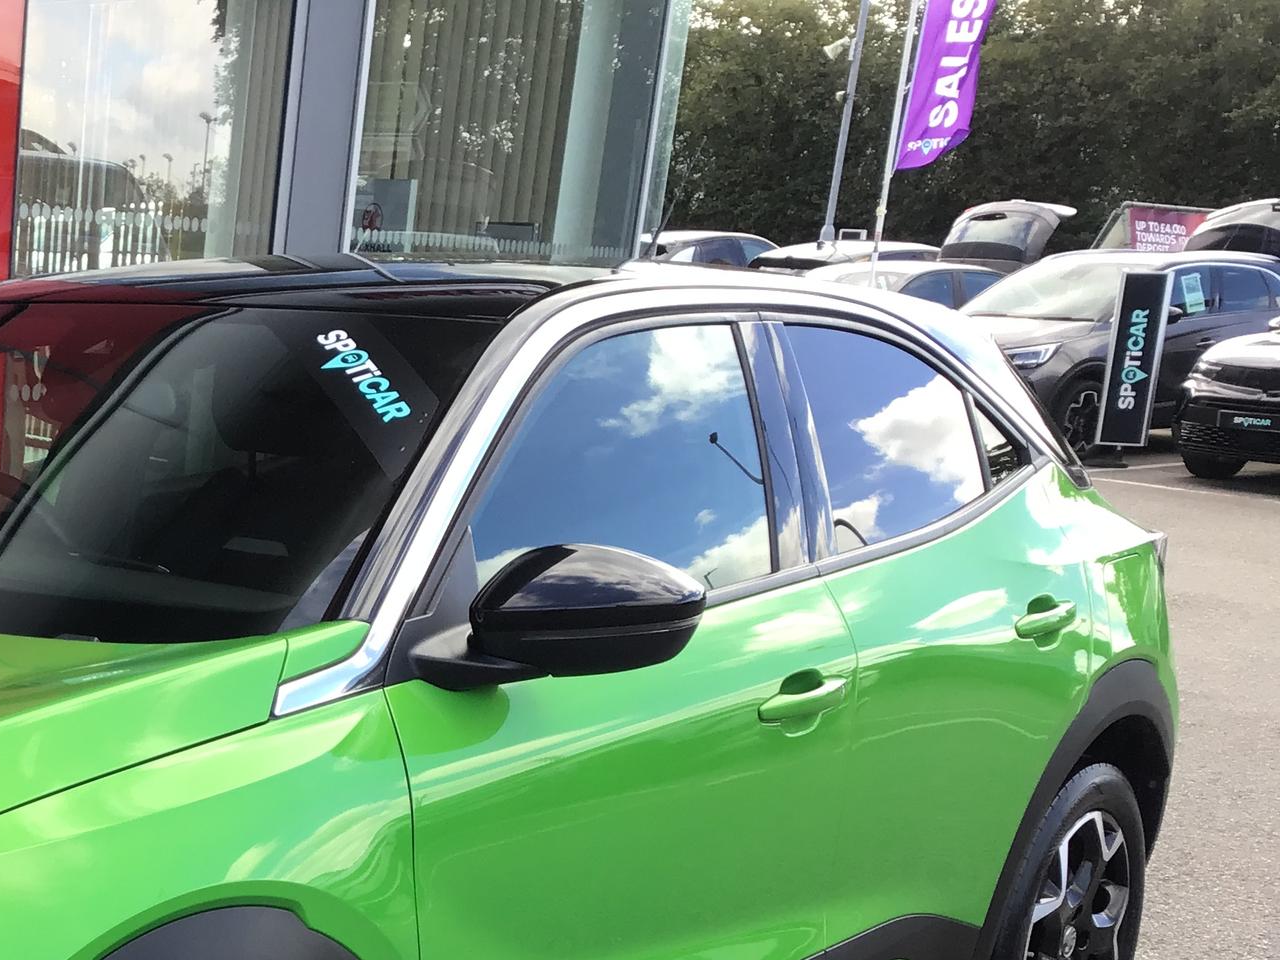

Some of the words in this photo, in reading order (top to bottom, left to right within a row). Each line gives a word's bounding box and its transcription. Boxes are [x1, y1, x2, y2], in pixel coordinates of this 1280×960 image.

[928, 0, 988, 128] SALES
[1135, 220, 1147, 231] UP
[1148, 221, 1160, 232] TO
[1135, 231, 1177, 244] TOWARDS
